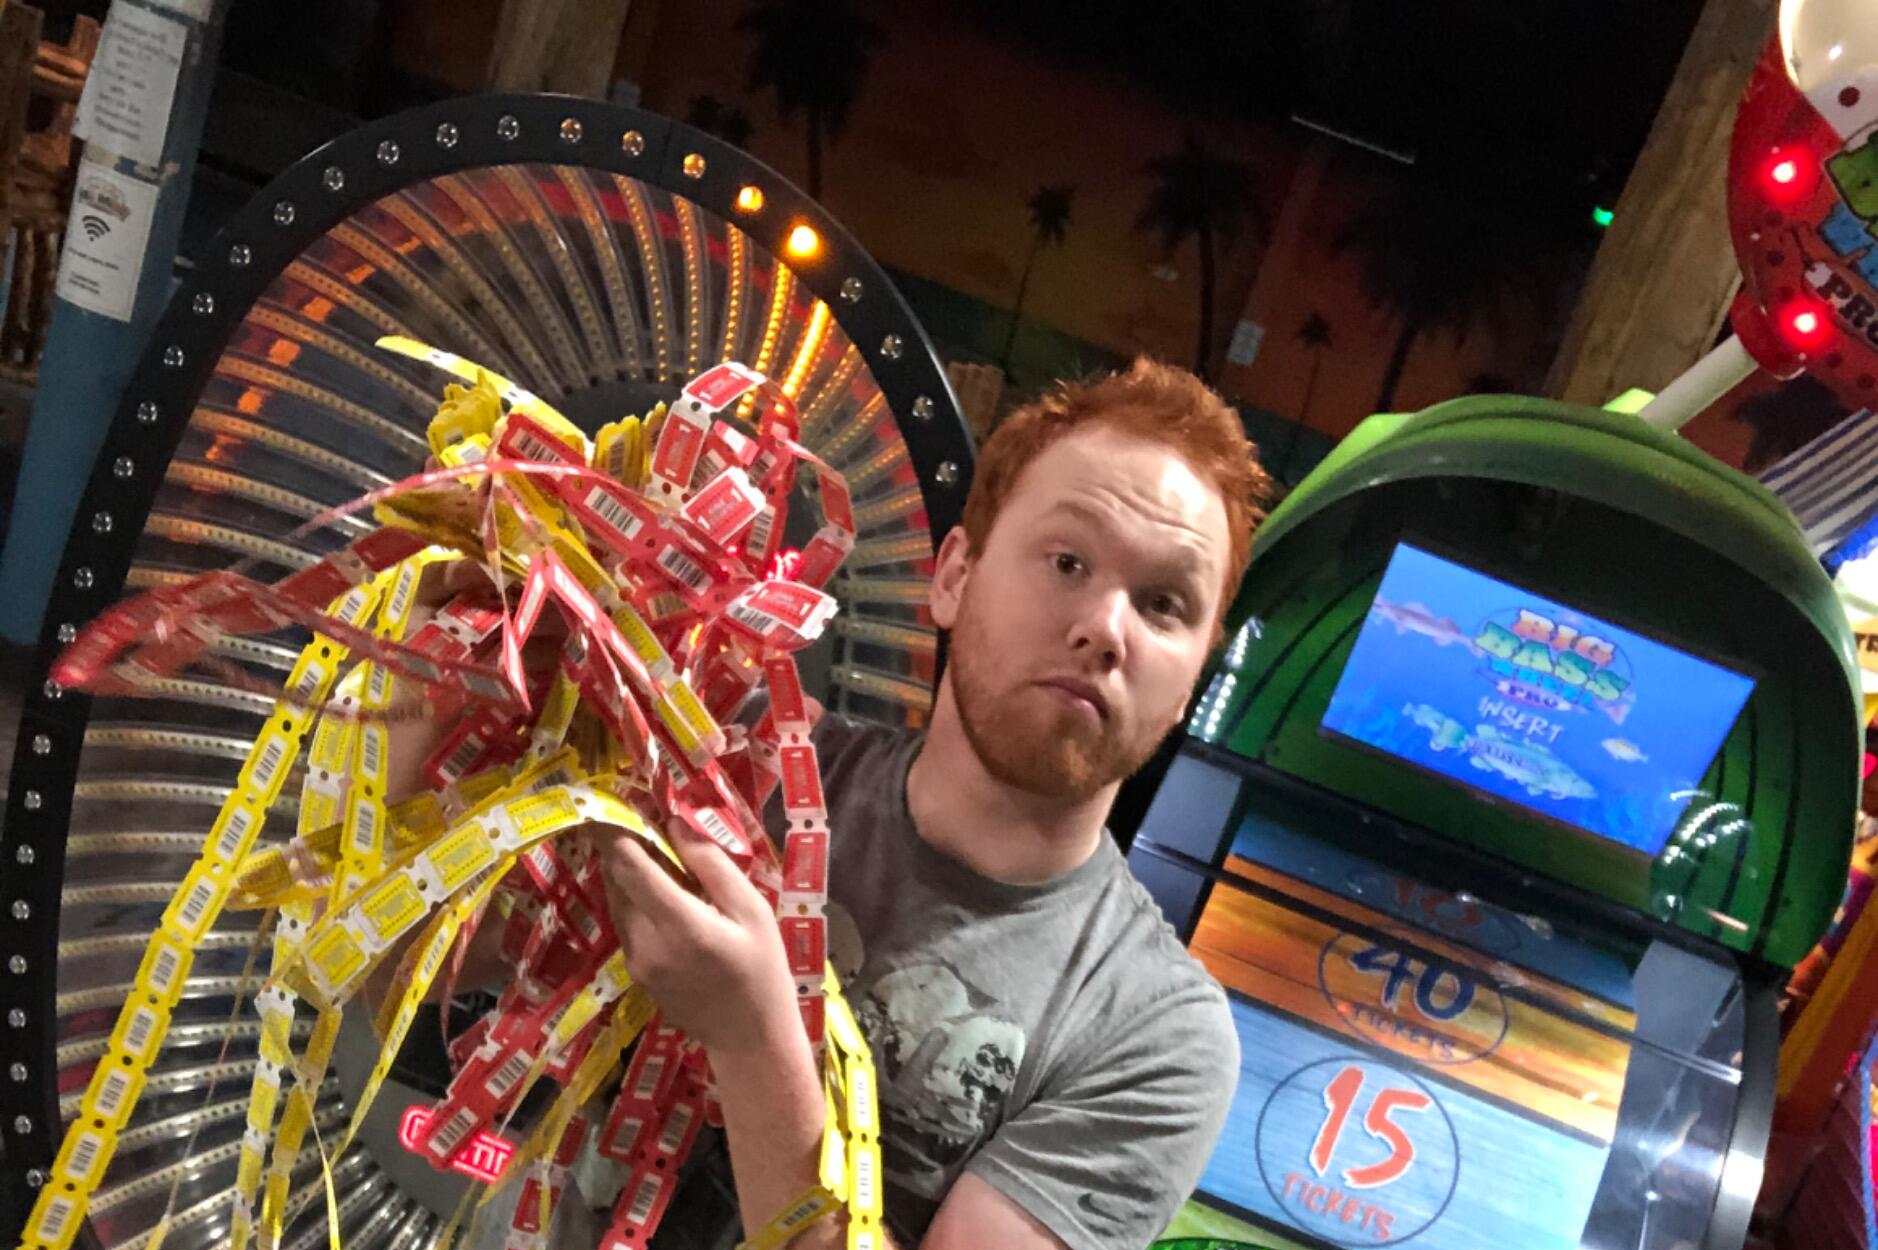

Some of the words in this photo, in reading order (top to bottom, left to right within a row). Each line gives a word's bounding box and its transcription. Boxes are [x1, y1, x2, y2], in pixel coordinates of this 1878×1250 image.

[1473, 621, 1631, 701] BASS
[1512, 609, 1616, 666] BIG
[1478, 695, 1565, 743] INSERT
[1348, 945, 1477, 1023] 40
[1309, 1065, 1432, 1189] 15
[1282, 1172, 1396, 1241] TICKETS
